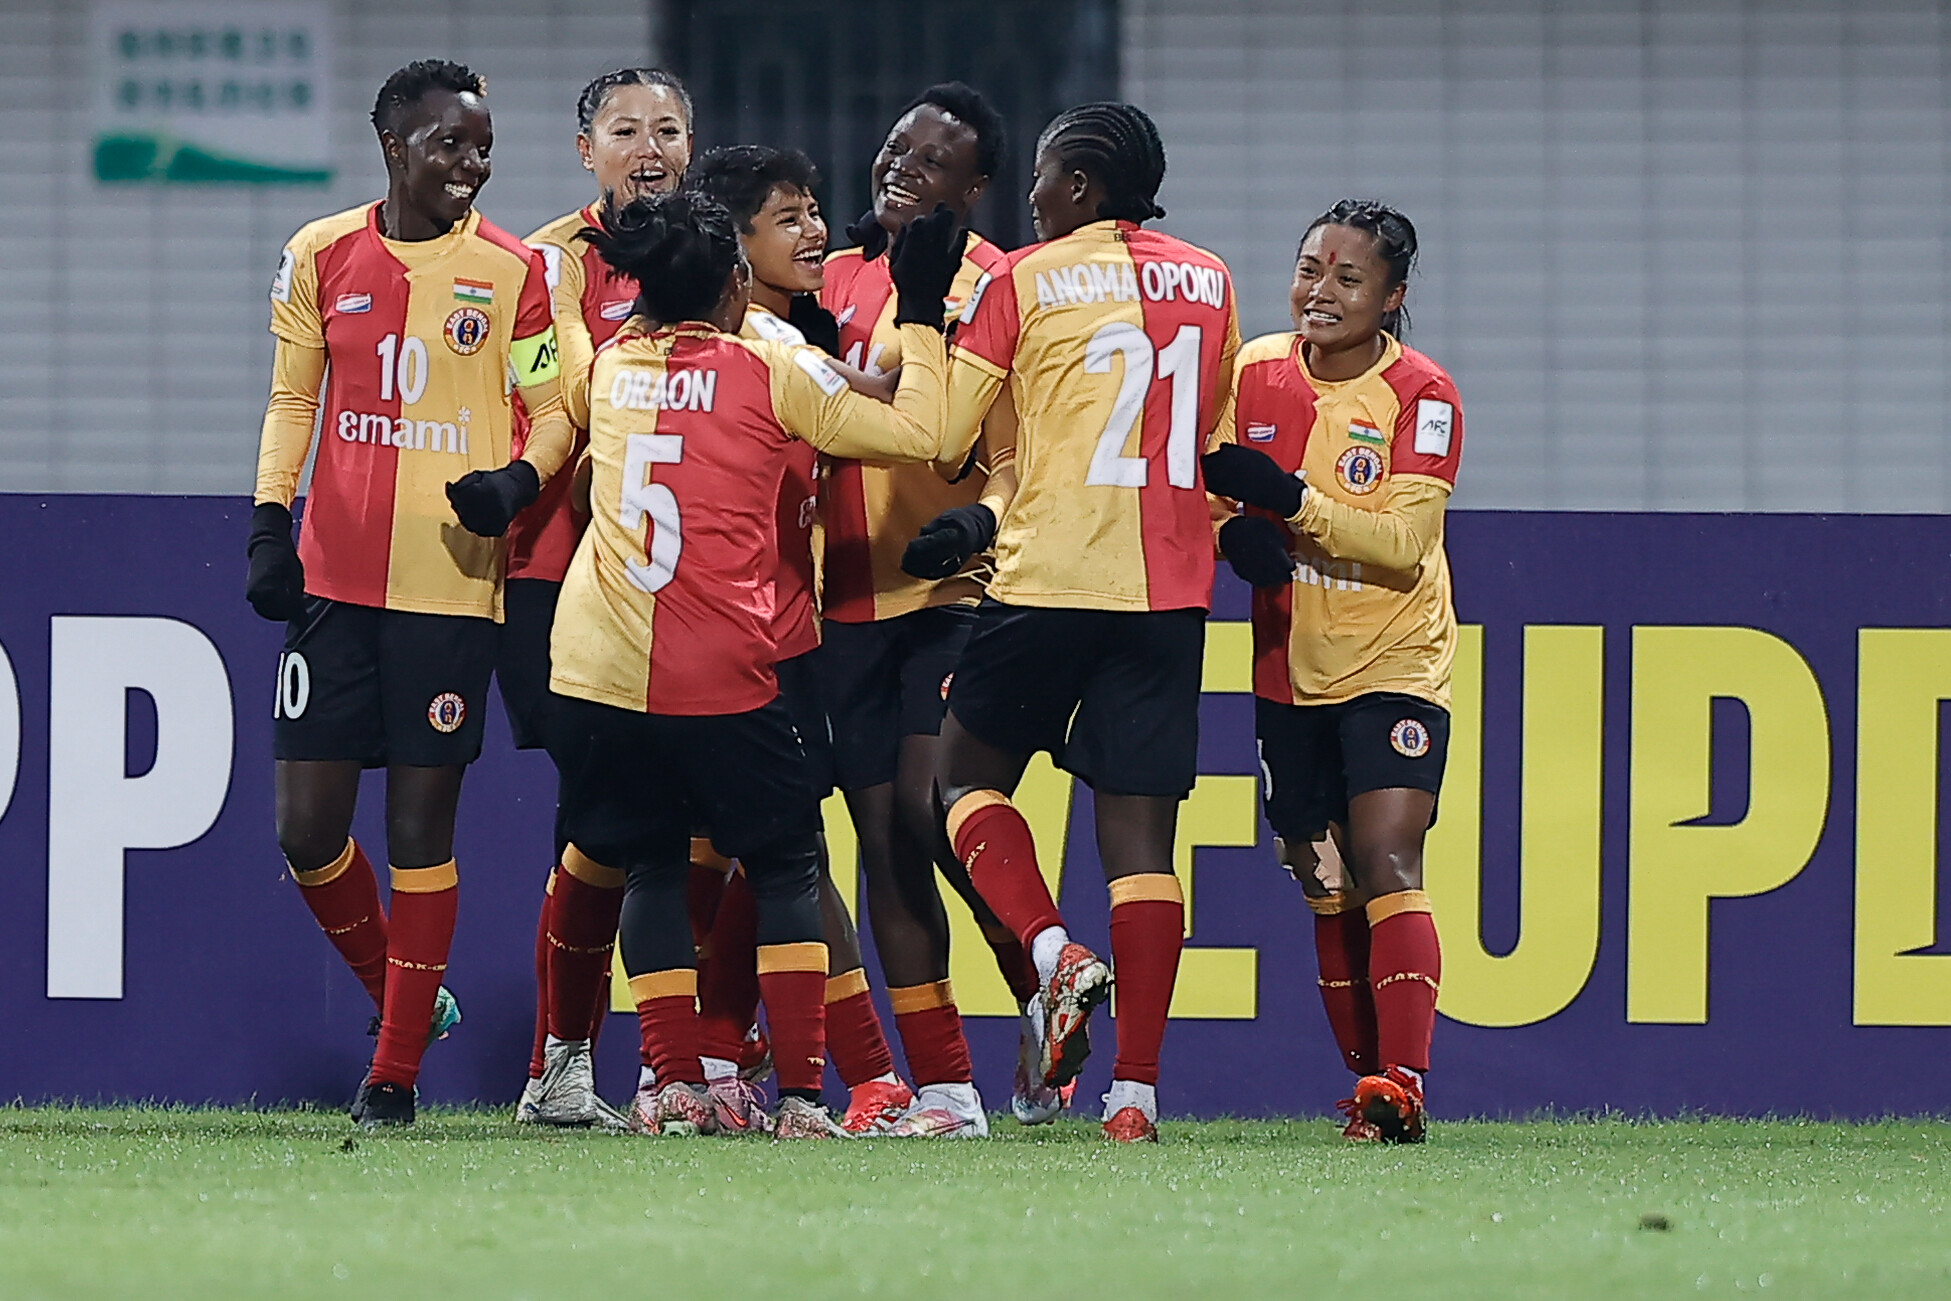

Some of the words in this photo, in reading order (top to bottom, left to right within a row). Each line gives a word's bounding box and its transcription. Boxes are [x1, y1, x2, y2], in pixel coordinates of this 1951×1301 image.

[1035, 263, 1141, 310] ANOMA
[1142, 261, 1224, 310] OPOKU
[377, 333, 428, 405] 10
[609, 369, 717, 413] ORAON
[338, 406, 472, 455] emami
[1083, 321, 1202, 490] 21
[618, 433, 683, 594] 5
[0, 615, 236, 1001] P
